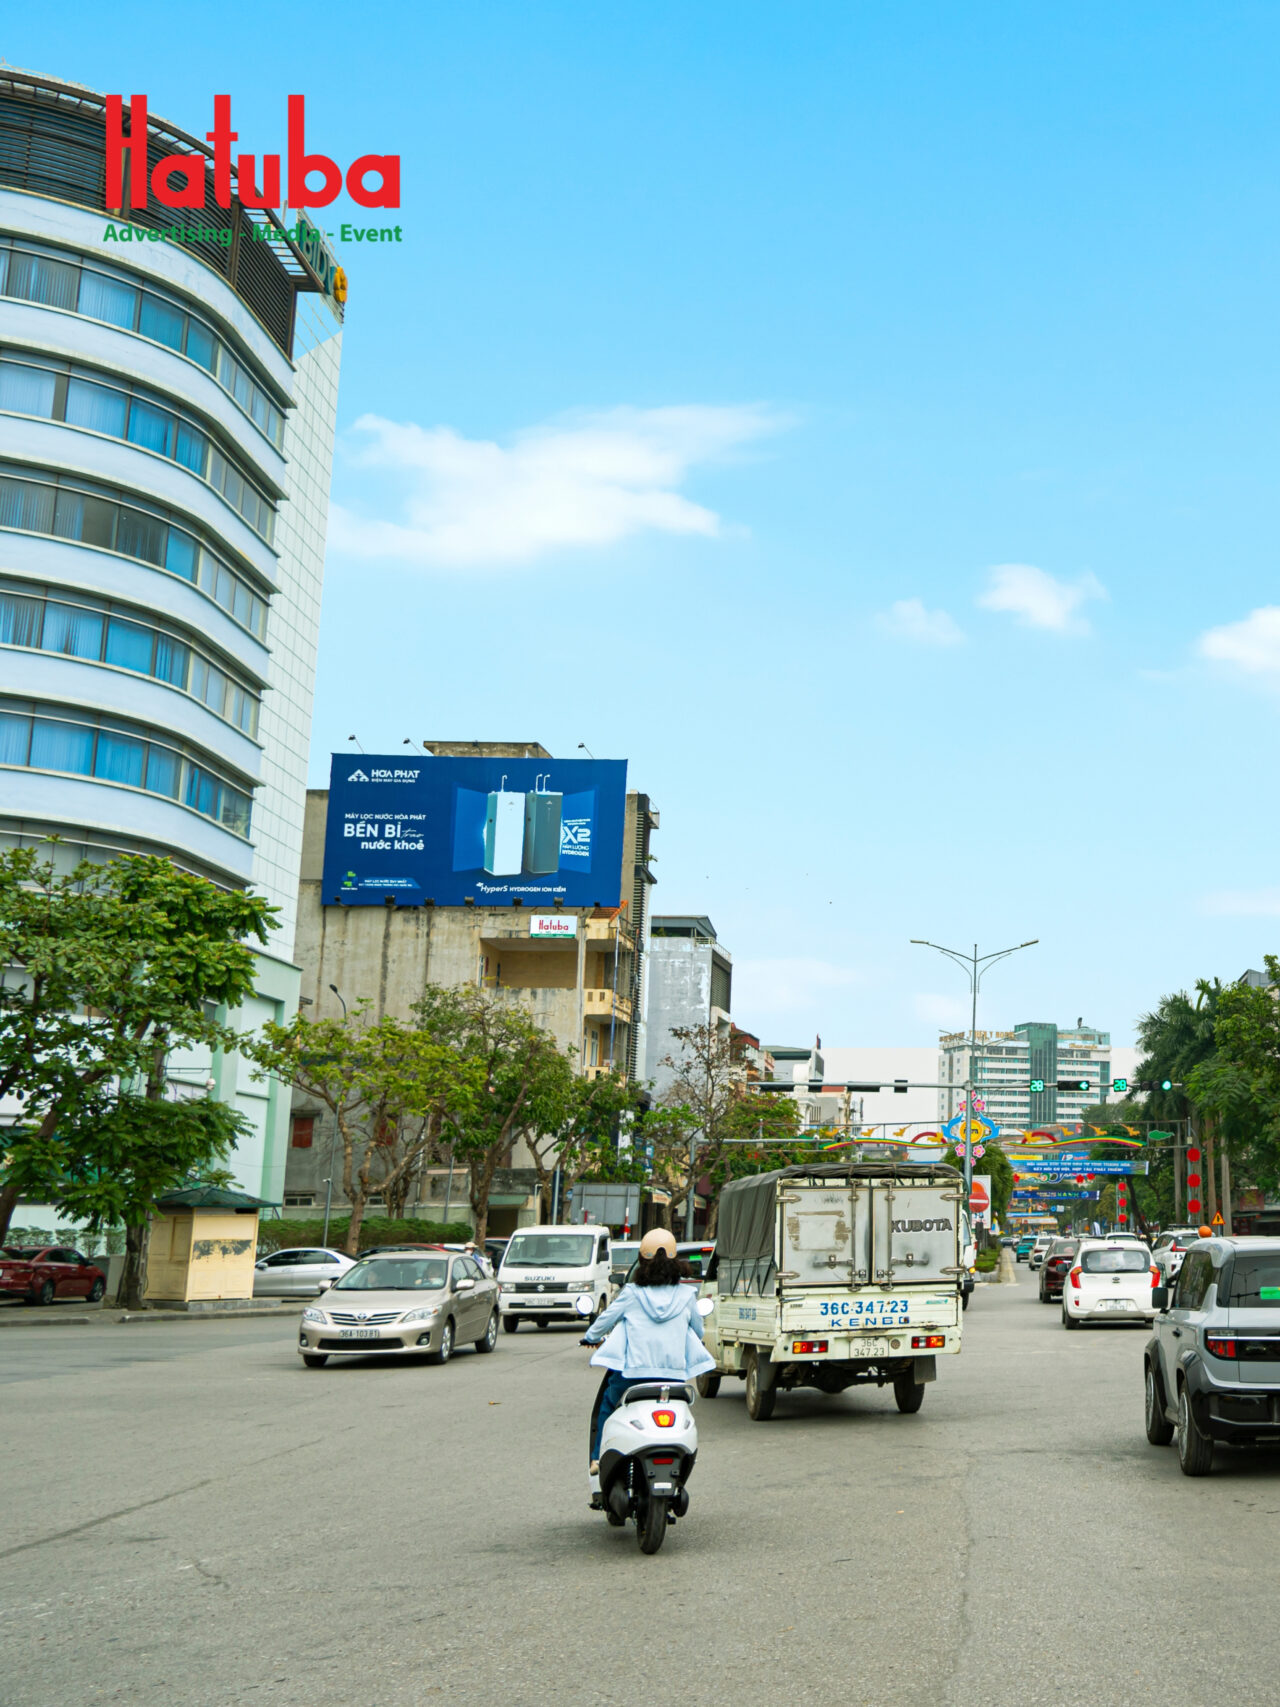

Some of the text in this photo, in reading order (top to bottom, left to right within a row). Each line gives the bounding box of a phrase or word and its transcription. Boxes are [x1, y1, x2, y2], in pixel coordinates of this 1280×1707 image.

[361, 839, 392, 850] nước
[539, 919, 569, 931] Hatuba
[1030, 1080, 1044, 1092] 28
[1113, 1079, 1127, 1091] 28
[891, 1218, 953, 1233] KUBOTA
[861, 1337, 877, 1347] 36C
[854, 1348, 885, 1357] 347.23
